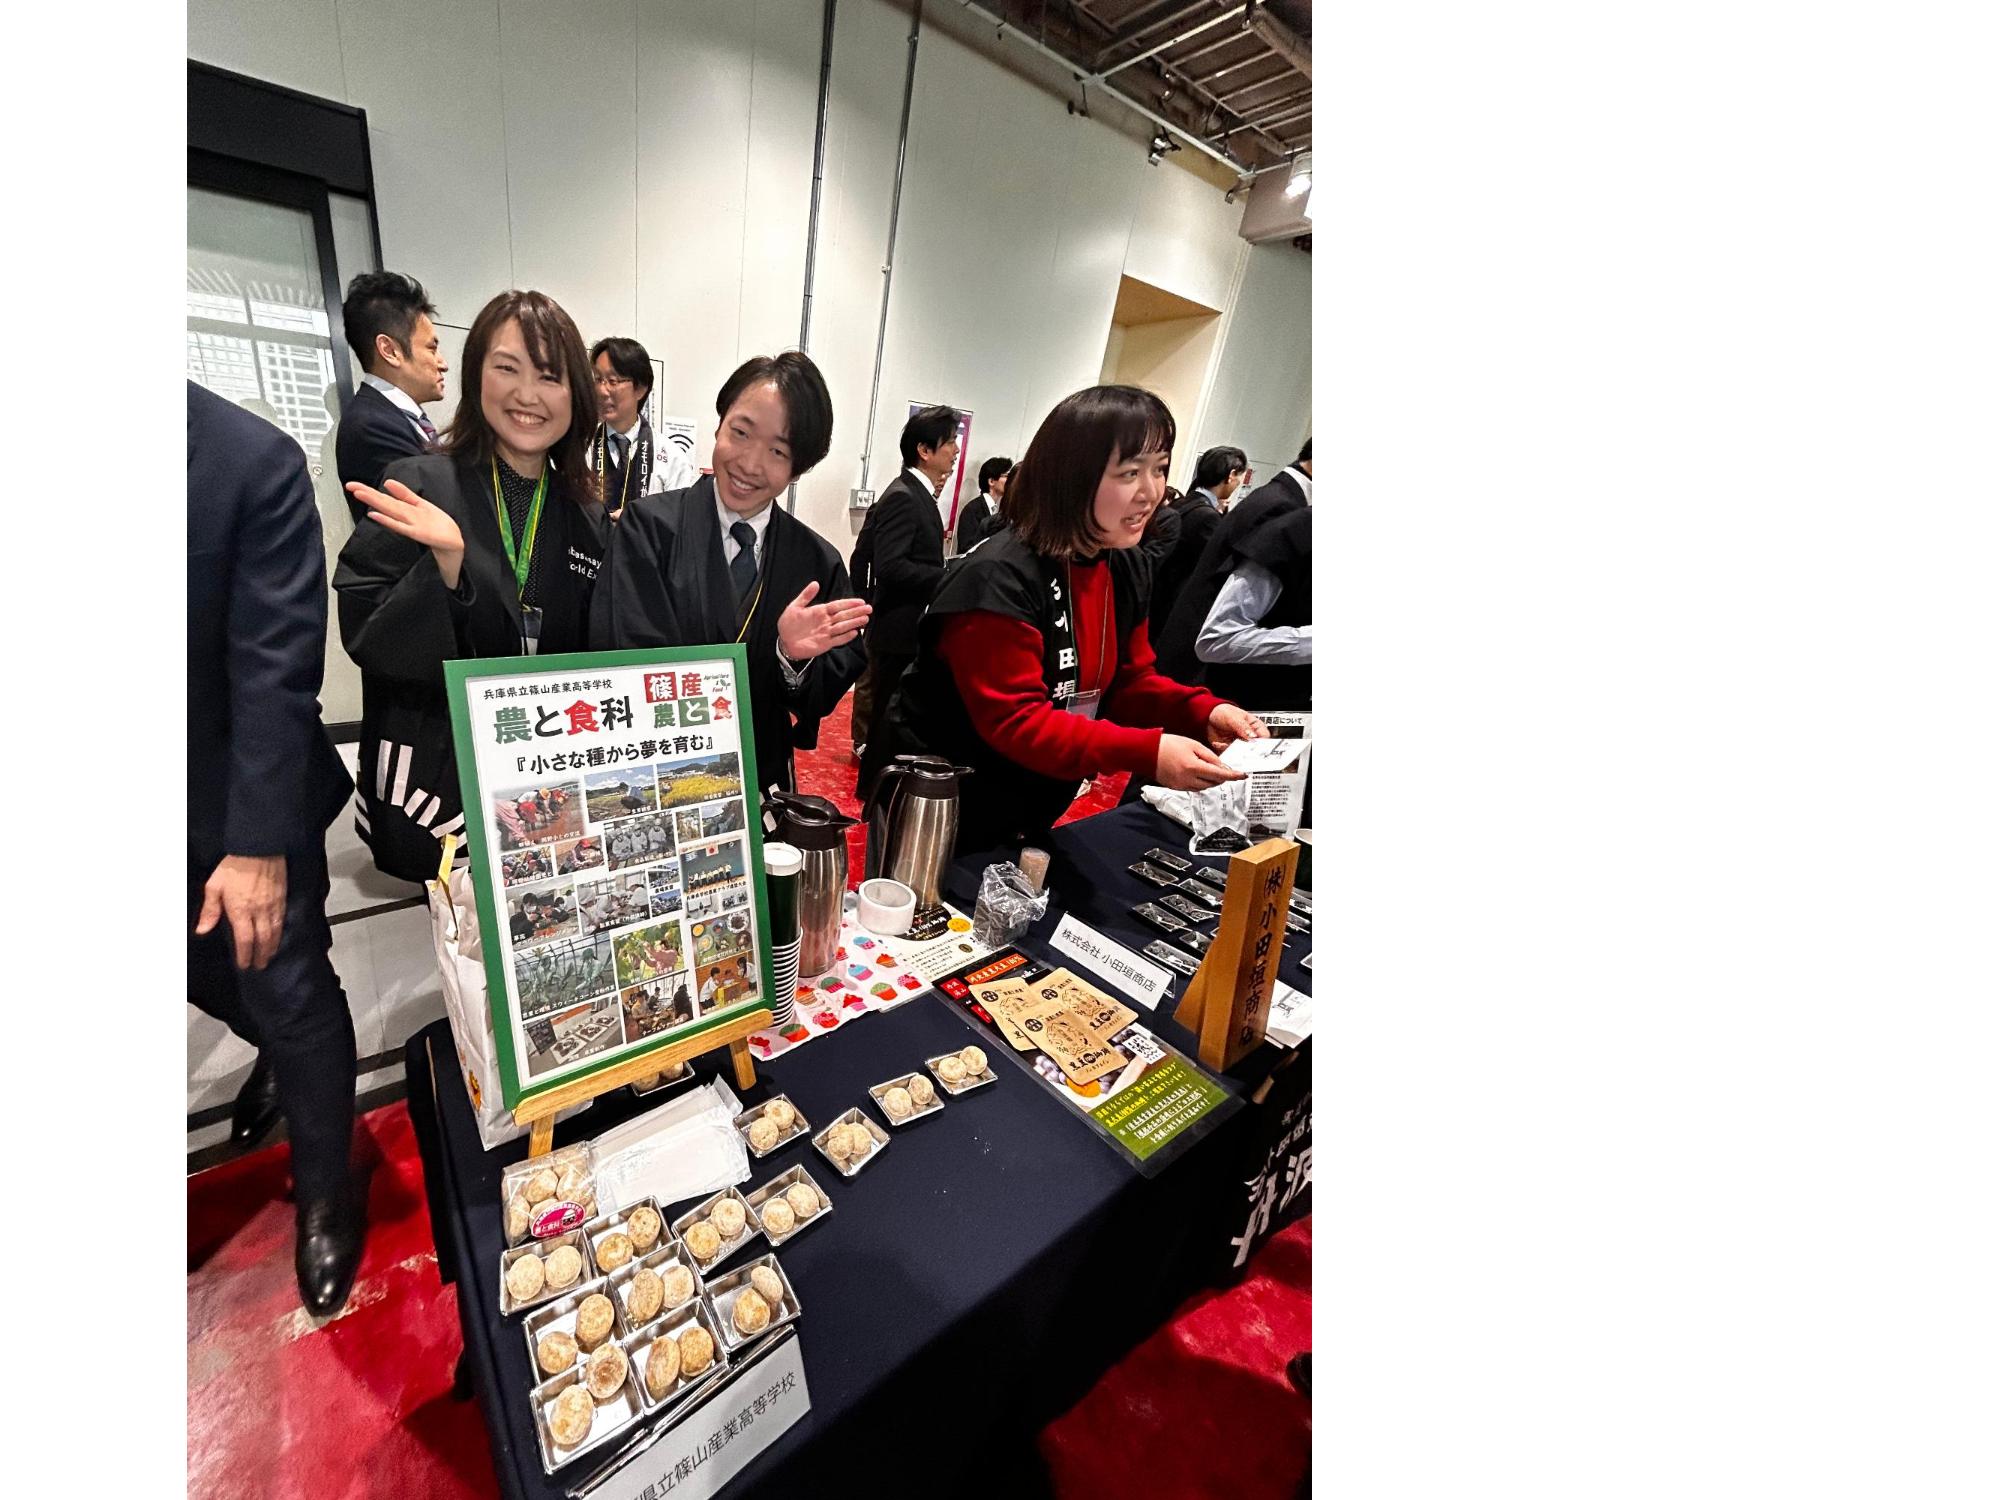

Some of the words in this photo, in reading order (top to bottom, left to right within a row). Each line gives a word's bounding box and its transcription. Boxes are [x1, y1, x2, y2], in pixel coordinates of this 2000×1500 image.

[483, 679, 613, 699] 兵庫県立篠山産業高等学校
[494, 695, 633, 744] 農と食科
[654, 696, 732, 729] 農と食
[517, 735, 713, 775] 『小さな種から夢を育む』
[1061, 926, 1101, 961] 株式会社
[1102, 953, 1157, 993] 小田垣商店
[634, 1371, 796, 1500] 県立篠山産業高等学校
